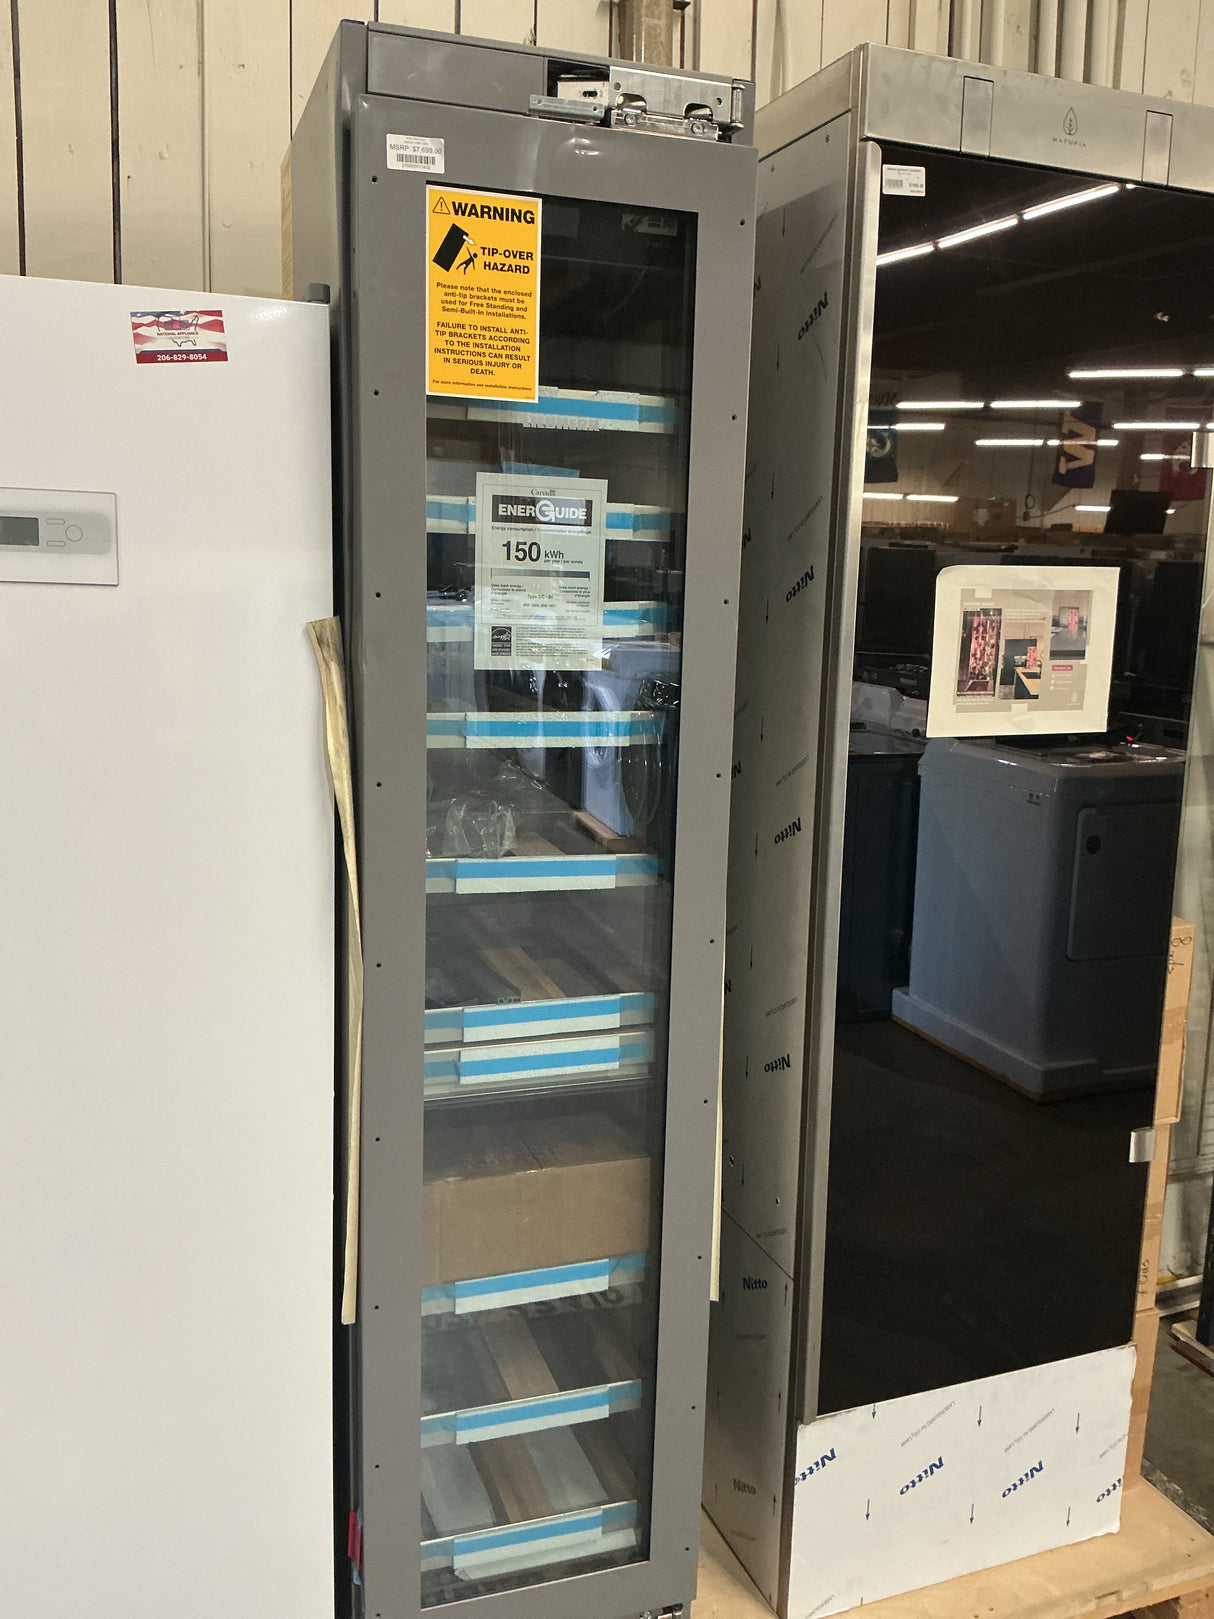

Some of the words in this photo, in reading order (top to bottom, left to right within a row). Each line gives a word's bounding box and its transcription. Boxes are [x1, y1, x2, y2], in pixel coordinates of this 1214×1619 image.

[451, 201, 535, 225] WARNING
[480, 246, 534, 261] TIP-OVER
[483, 261, 530, 275] HAZARD
[436, 282, 458, 290] Please
[444, 291, 467, 299] anti-tip
[469, 293, 498, 301] brackets
[442, 306, 484, 315] Semi-Built-In
[486, 311, 526, 319] installations.
[486, 303, 514, 312] Standing
[798, 291, 829, 340] Nitto
[436, 321, 466, 330] FAILURE
[480, 326, 508, 334] INSTALL
[448, 331, 487, 340] BRACKETS
[488, 335, 530, 344] ACCORDING
[472, 342, 521, 352] INSTALLATION
[434, 348, 486, 358] INSTRUCTIONS
[505, 354, 531, 362] RESULT
[452, 358, 484, 366] SERIOUS
[470, 368, 496, 376] DEATH.
[498, 500, 587, 522] ENERGUIDE
[502, 541, 541, 562] 150
[544, 550, 564, 559] kWh
[786, 565, 815, 602] Nitto
[774, 816, 802, 844] Nitto
[764, 1054, 791, 1073] Nitto
[743, 1277, 768, 1291] Nitto
[900, 1456, 944, 1495] Nitto
[1002, 1460, 1044, 1498] Nitto
[733, 1478, 757, 1495] Nitto
[1096, 1478, 1122, 1502] itto
